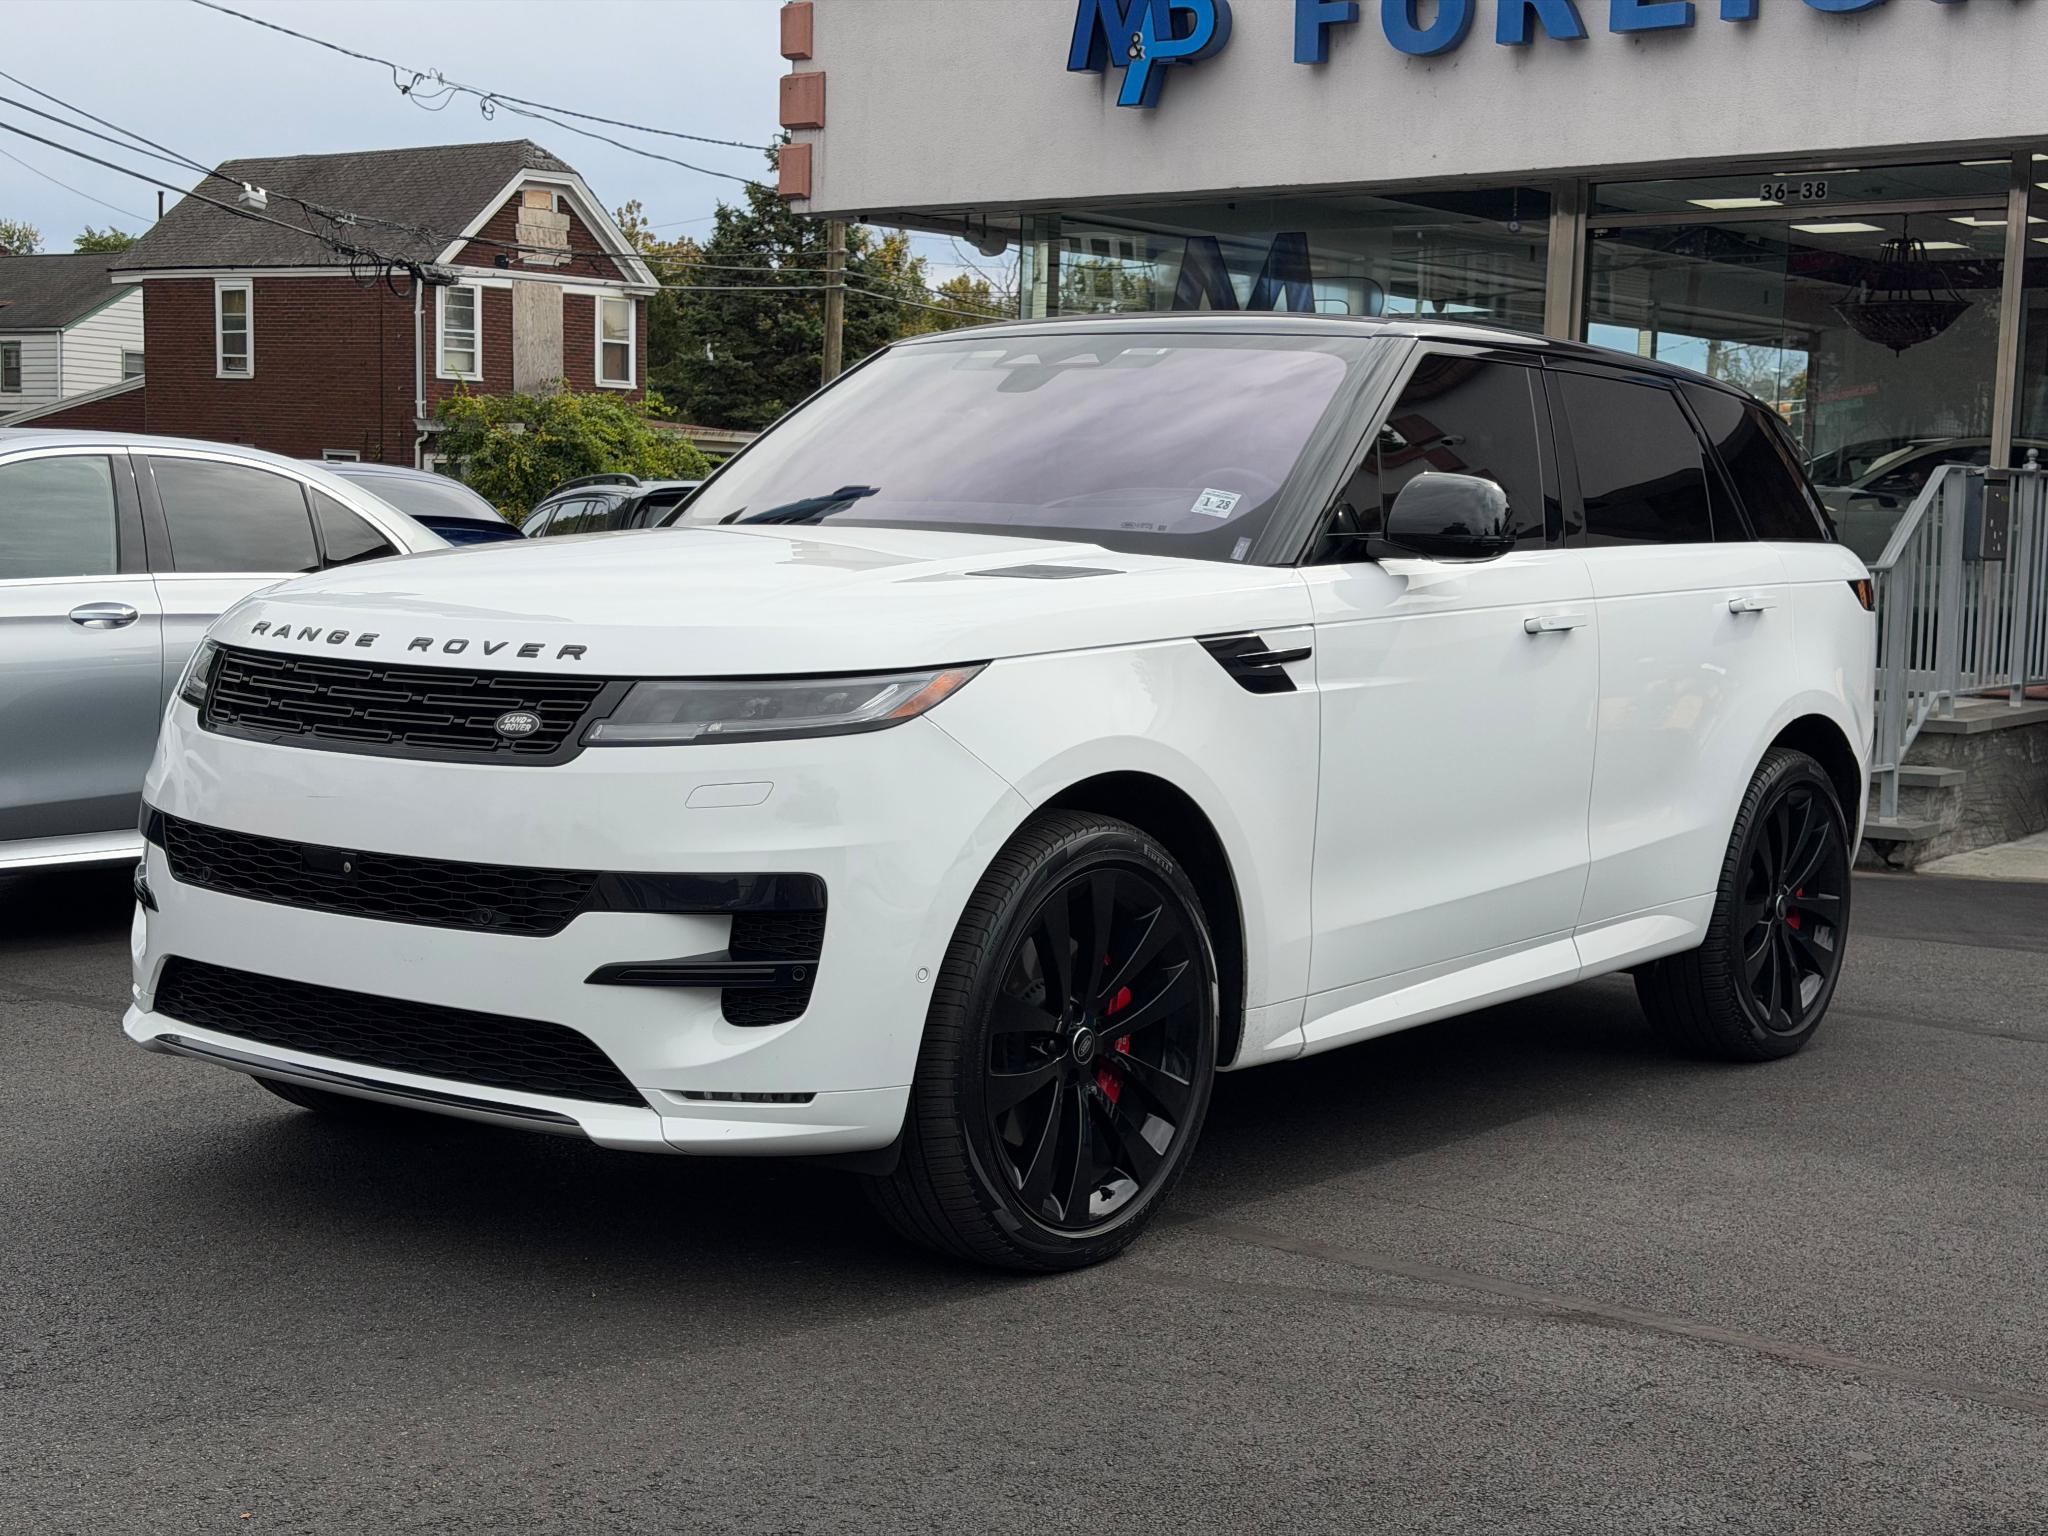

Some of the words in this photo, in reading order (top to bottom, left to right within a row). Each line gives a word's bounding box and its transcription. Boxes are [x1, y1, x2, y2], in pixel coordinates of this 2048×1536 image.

[1761, 182, 1826, 200] 36-38
[1216, 499, 1231, 510] 28
[251, 620, 380, 648] RANGE
[407, 636, 588, 661] ROVER
